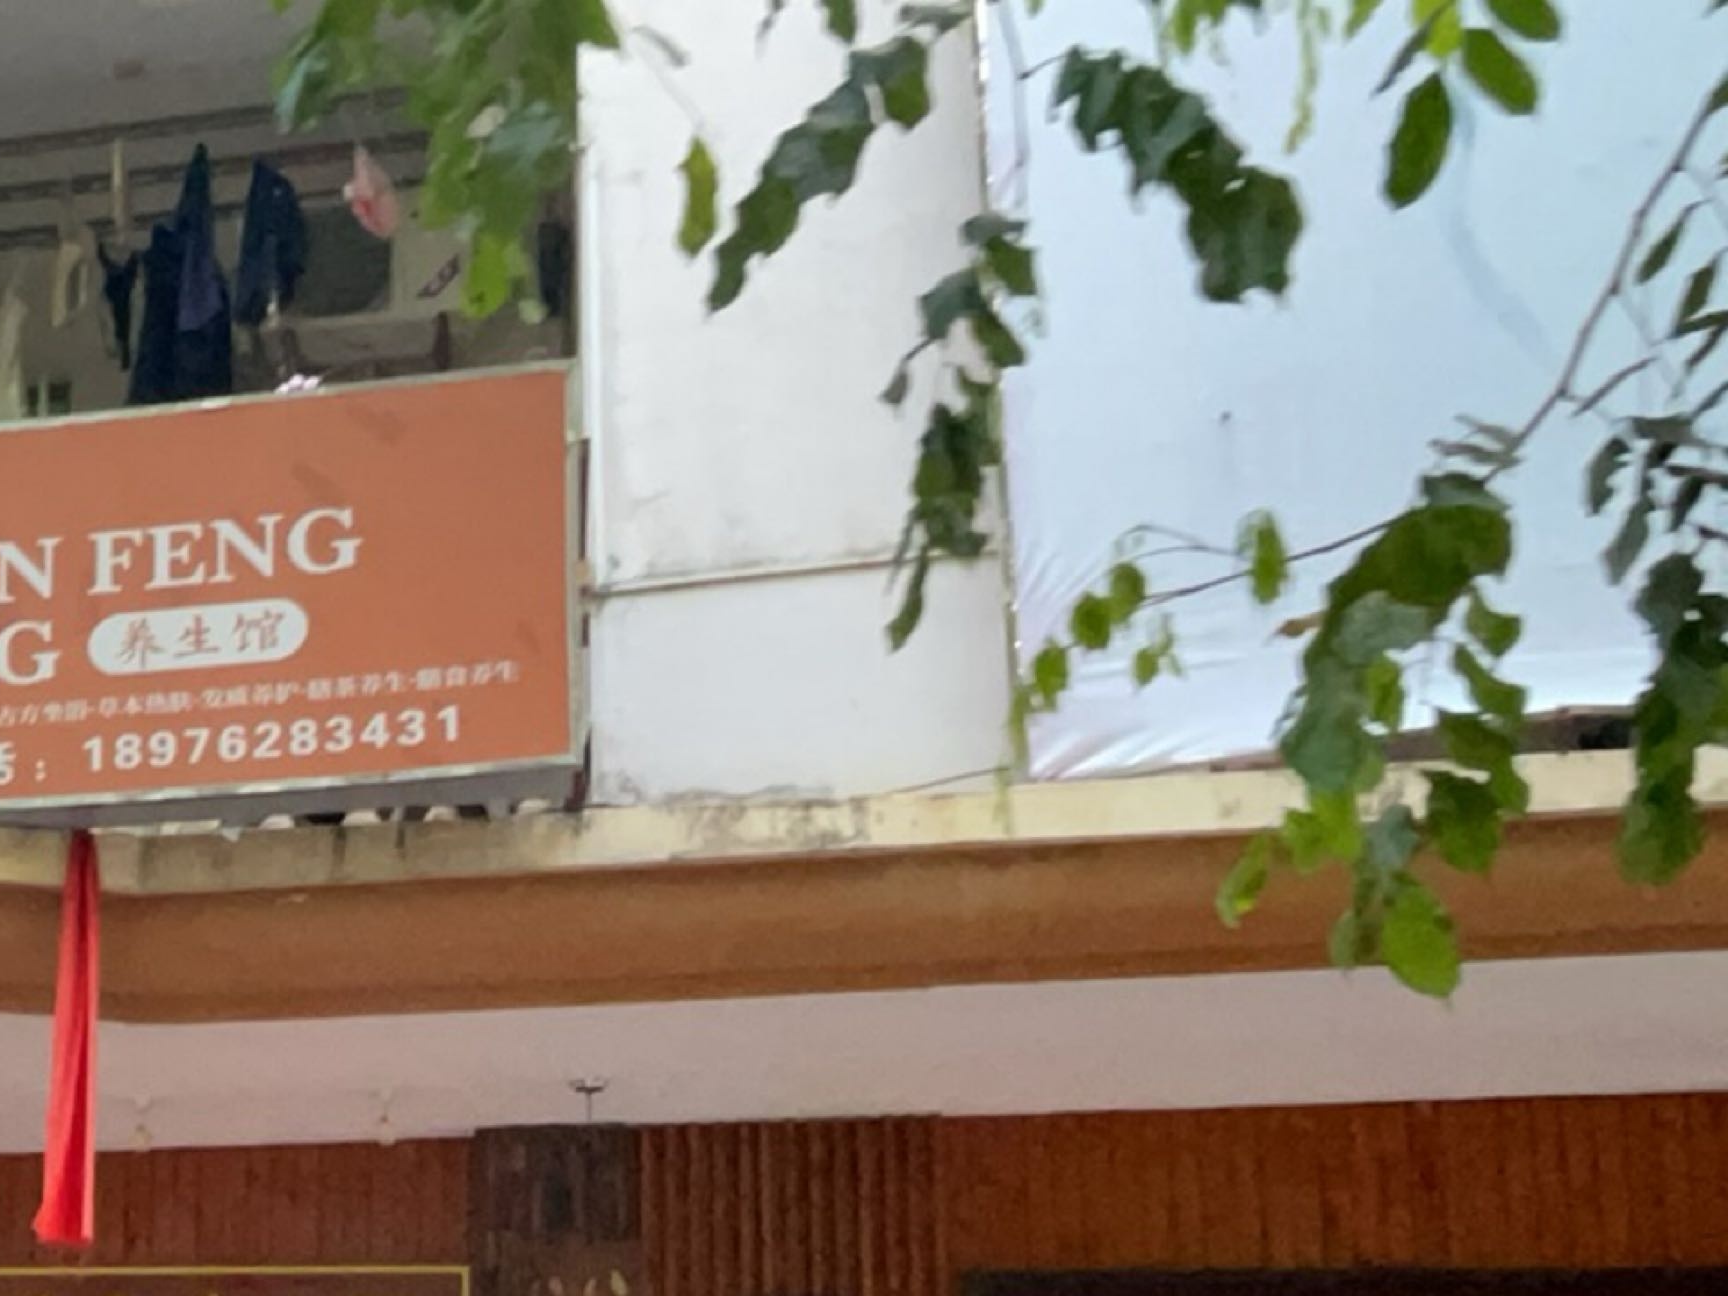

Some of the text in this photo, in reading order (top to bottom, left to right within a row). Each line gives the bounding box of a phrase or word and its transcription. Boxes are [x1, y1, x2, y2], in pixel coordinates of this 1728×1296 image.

[87, 506, 361, 597] FENG
[114, 608, 289, 668] 养生馆
[83, 703, 460, 773] 18976283431
